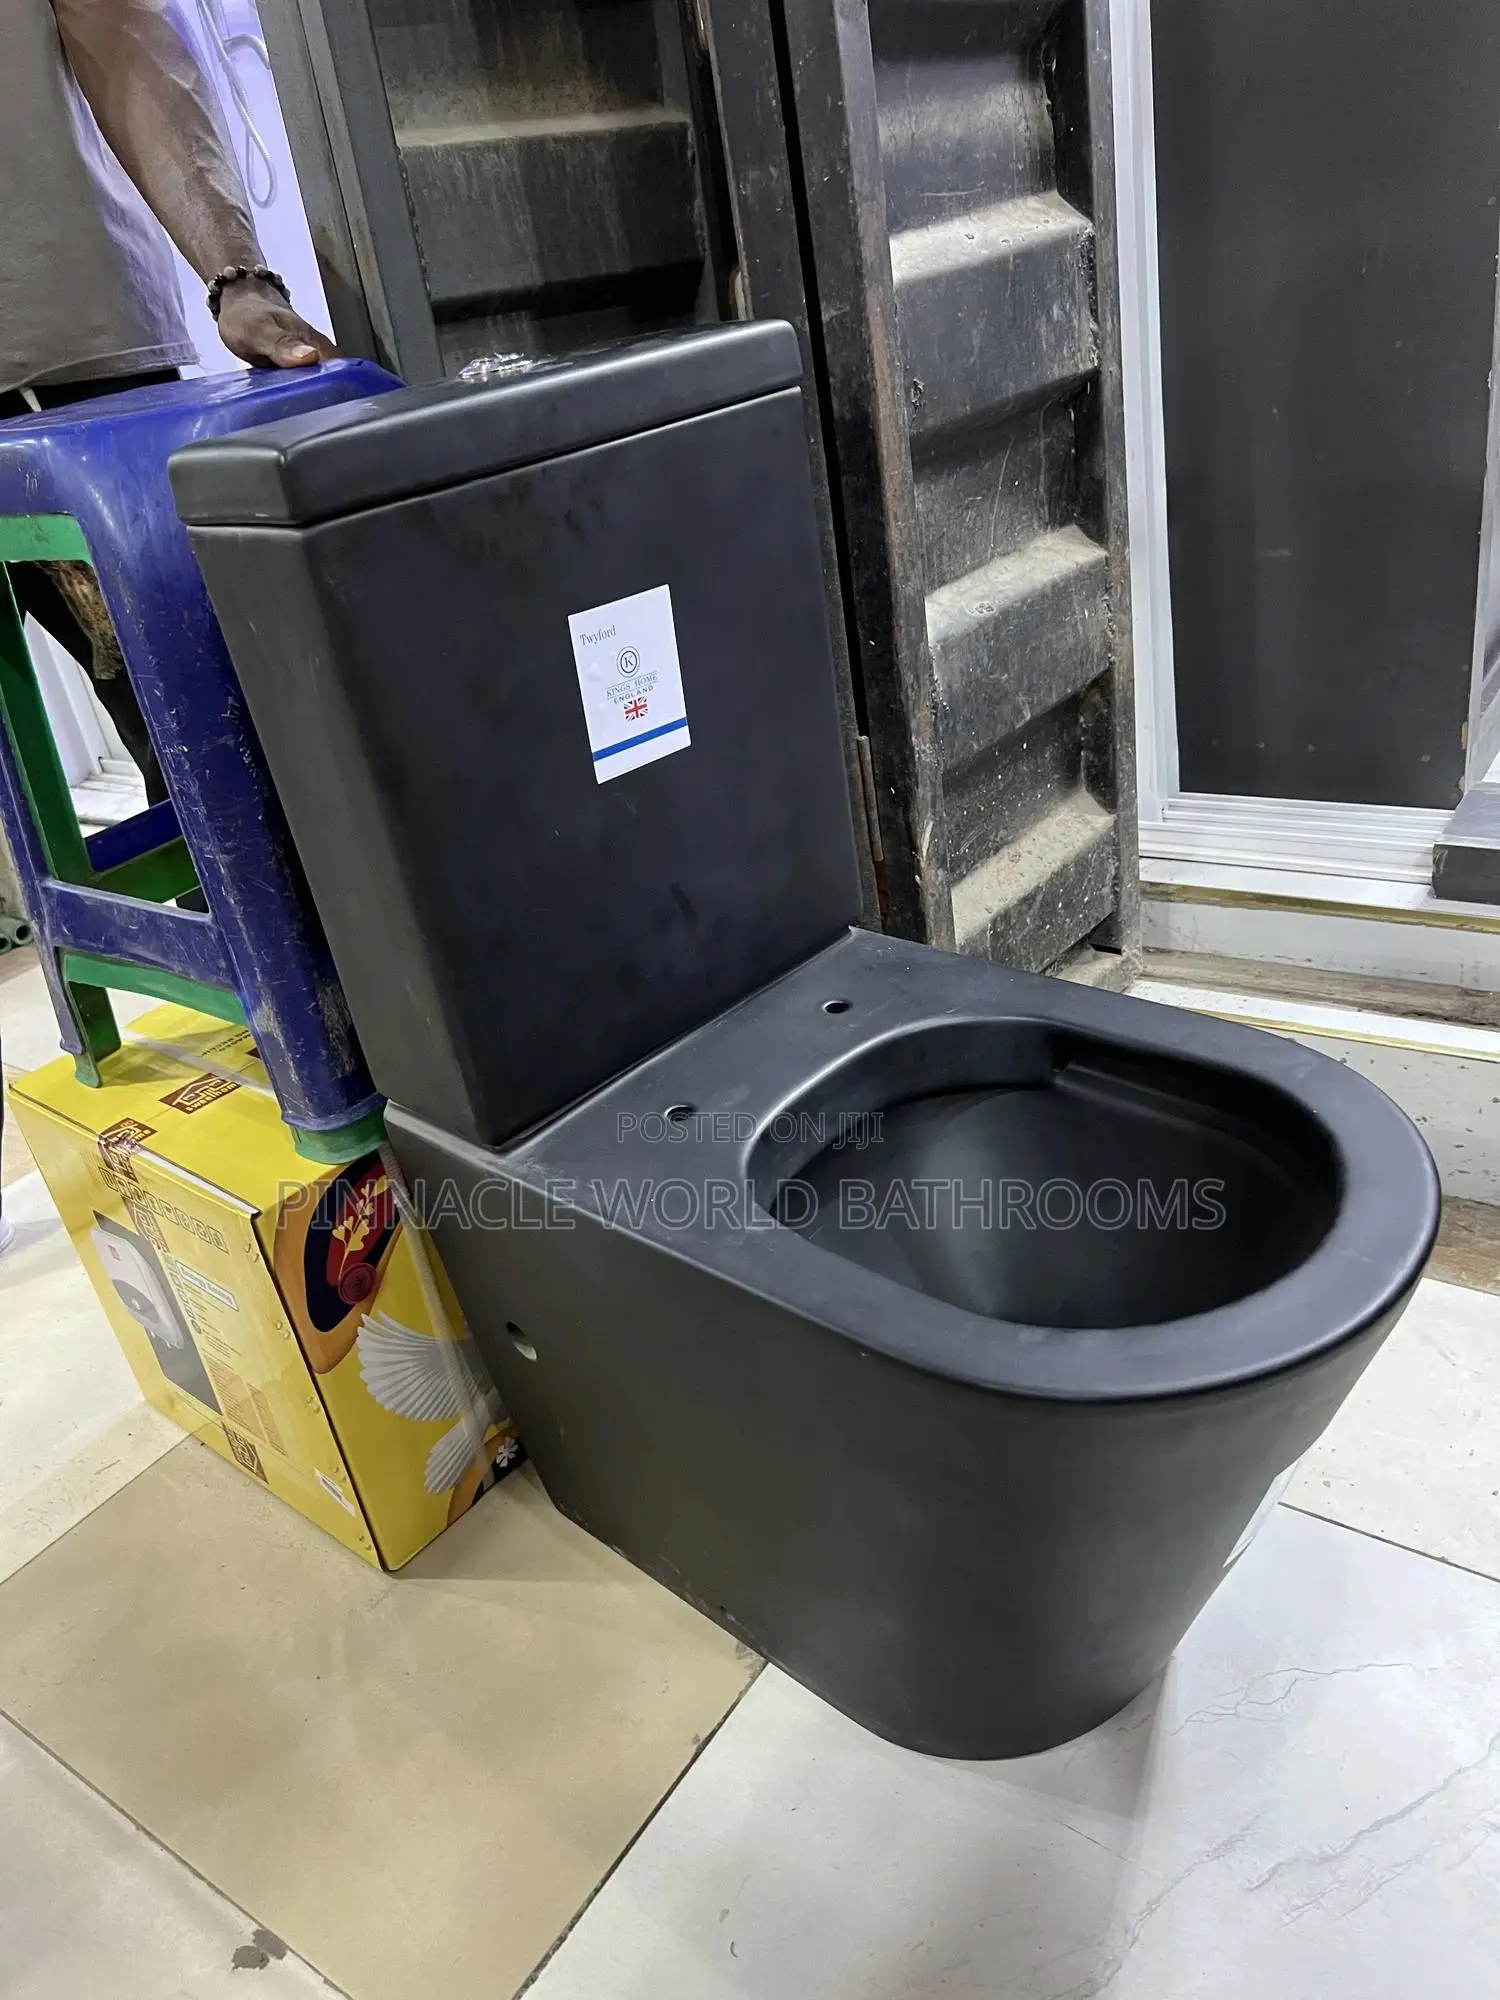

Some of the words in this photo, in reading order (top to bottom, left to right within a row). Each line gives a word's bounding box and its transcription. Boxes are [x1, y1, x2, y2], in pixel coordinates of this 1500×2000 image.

[580, 625, 616, 646] Twyford
[624, 655, 633, 668] K
[606, 683, 631, 697] KINGS
[635, 673, 657, 687] HOME
[613, 685, 653, 704] ENGLAND
